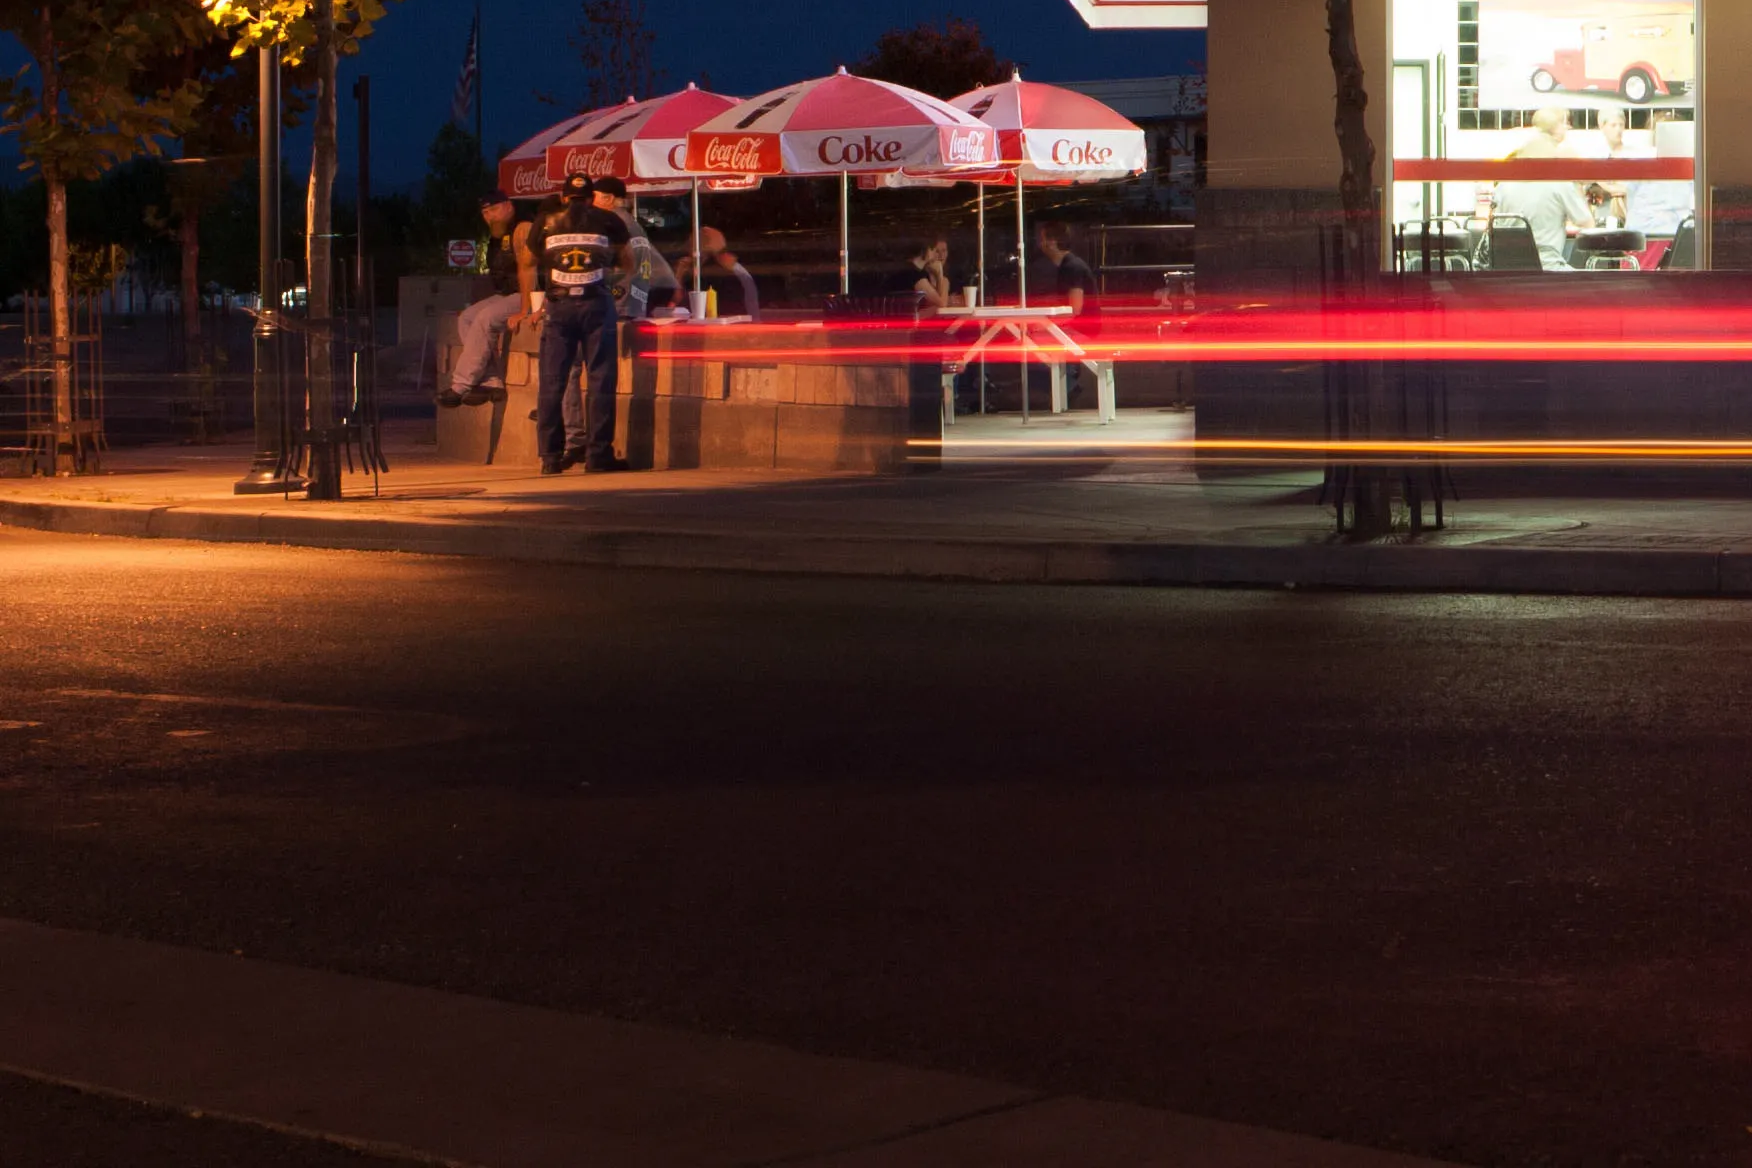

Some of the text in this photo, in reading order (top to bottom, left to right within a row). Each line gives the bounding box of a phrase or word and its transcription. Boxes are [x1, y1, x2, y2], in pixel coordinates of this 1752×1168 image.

[564, 145, 618, 177] Coca-Cola
[704, 136, 765, 170] Coca-Cola
[817, 134, 903, 166] Coke
[1051, 138, 1113, 167] Coke
